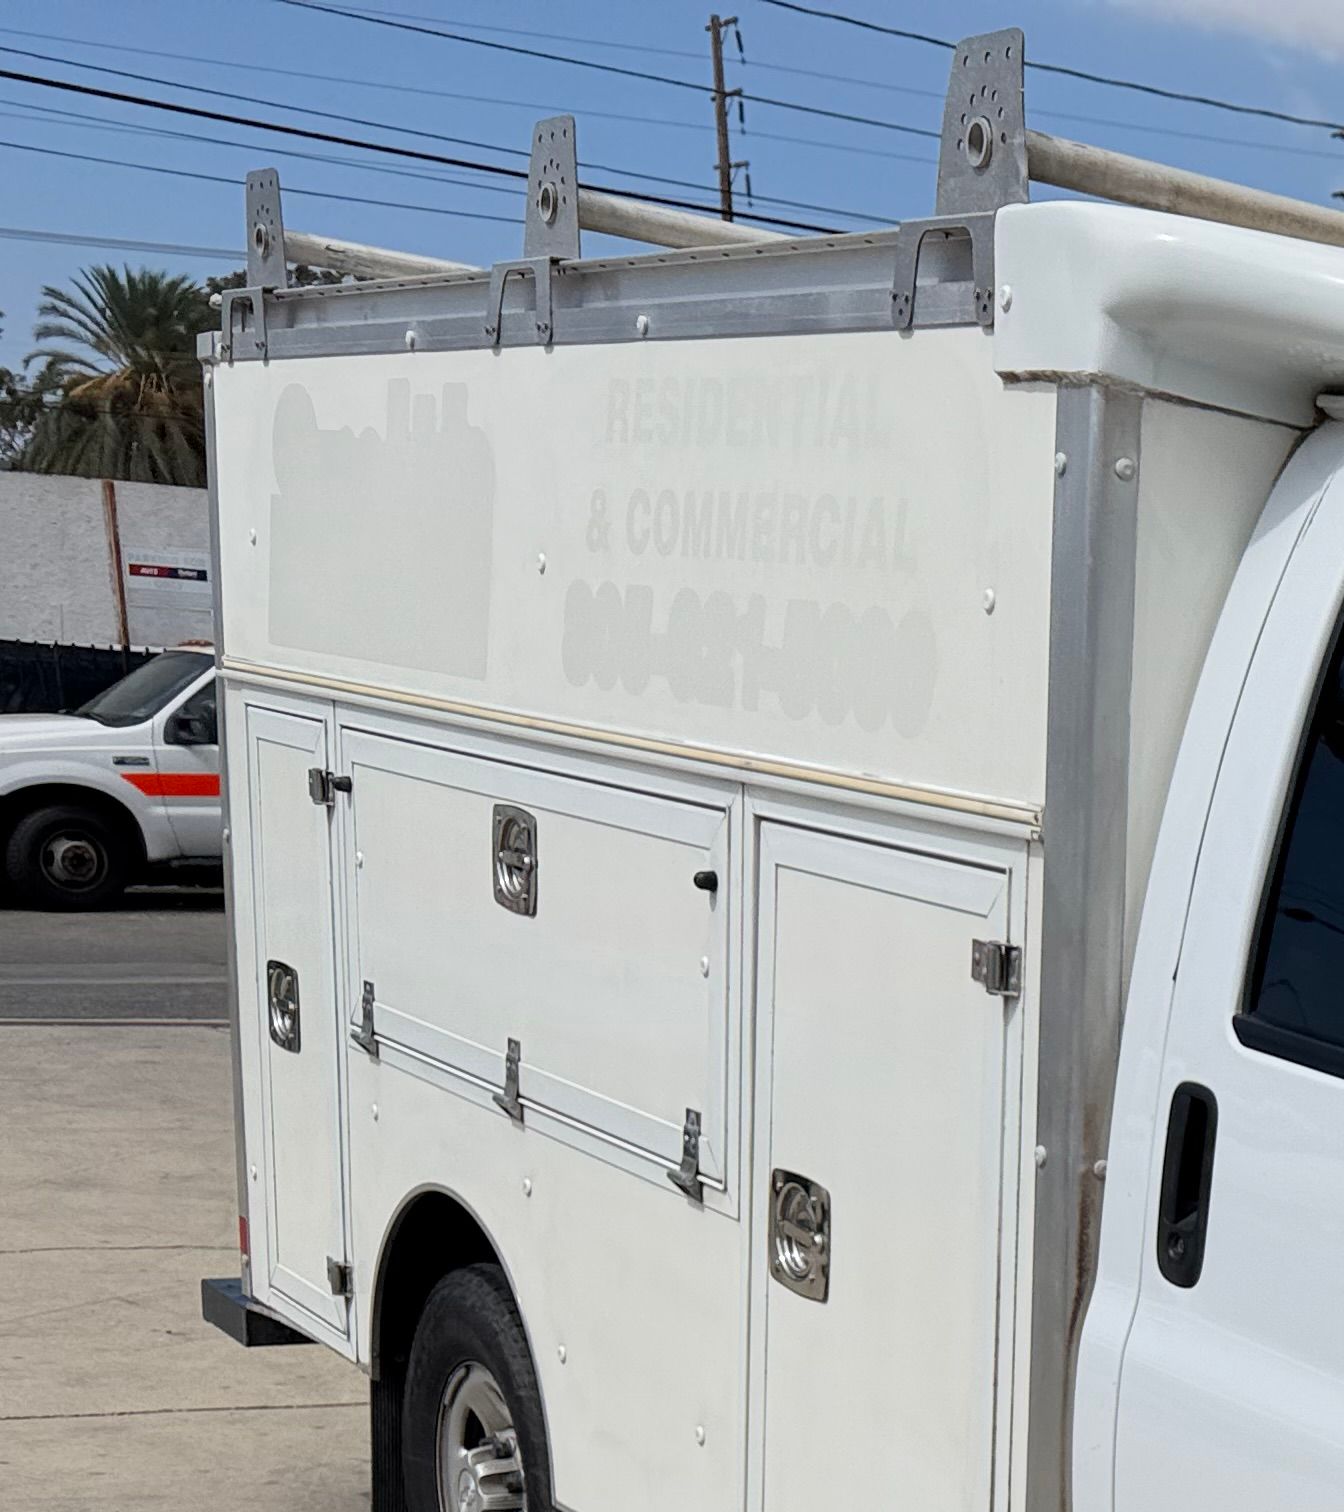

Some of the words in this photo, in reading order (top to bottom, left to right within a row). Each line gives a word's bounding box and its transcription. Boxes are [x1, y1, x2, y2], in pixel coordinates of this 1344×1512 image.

[603, 373, 892, 449] RESIDENTIAL
[585, 487, 612, 554] &
[625, 487, 919, 573] COMMERCIAL
